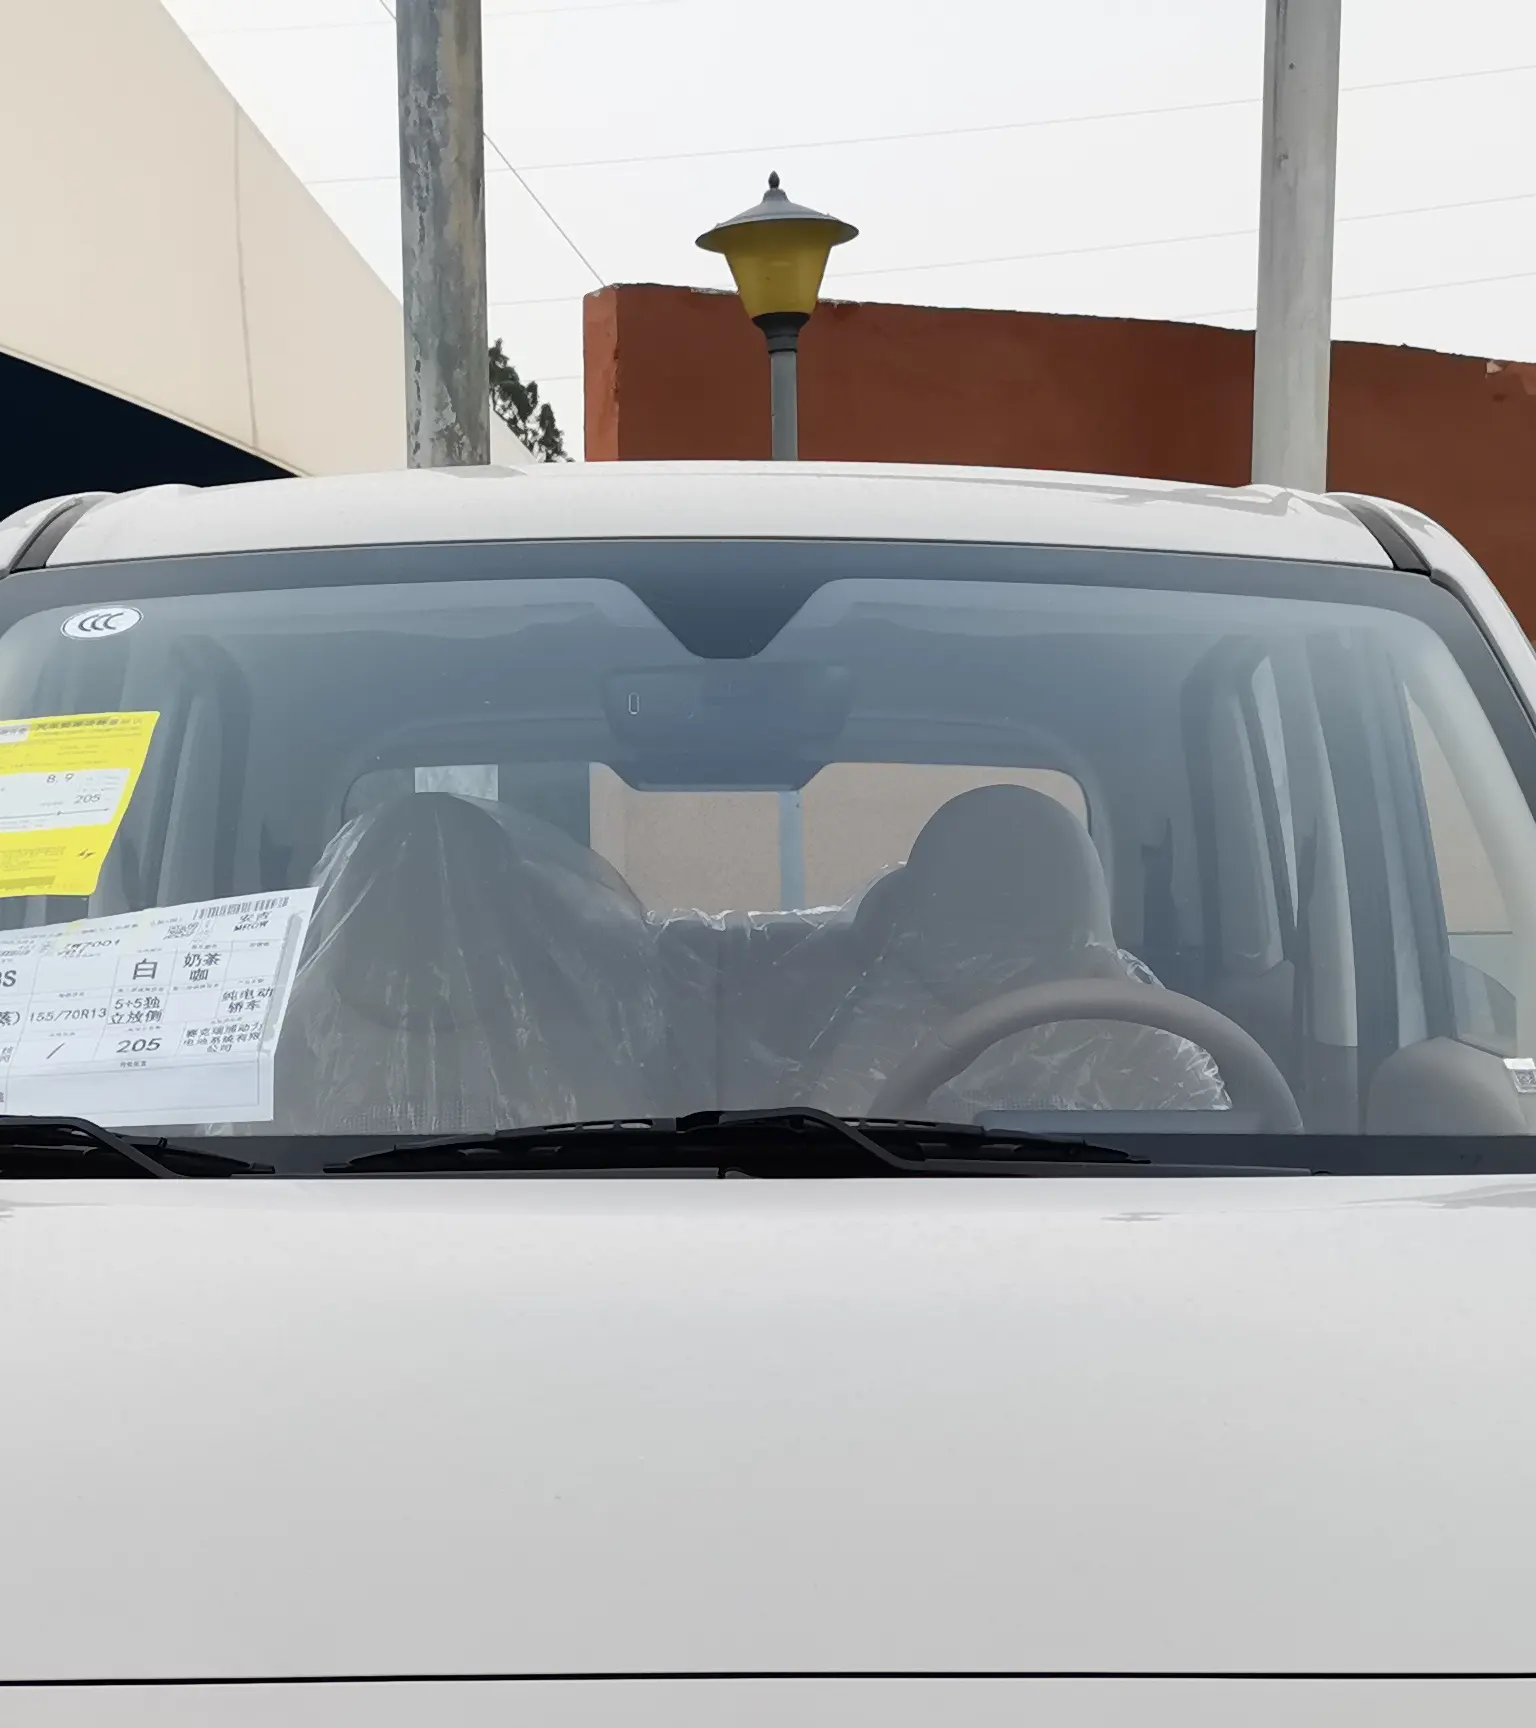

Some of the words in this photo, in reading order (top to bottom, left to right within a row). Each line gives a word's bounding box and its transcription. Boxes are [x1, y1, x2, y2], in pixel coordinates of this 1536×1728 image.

[73, 793, 101, 804] 205
[183, 952, 222, 968] 奶茶
[132, 958, 158, 981] 白
[189, 968, 209, 981] 咖
[222, 987, 274, 1000] 纯电动
[114, 996, 161, 1011] 5+5独
[29, 1008, 107, 1023] 155/70R13
[116, 1038, 163, 1054] 205
